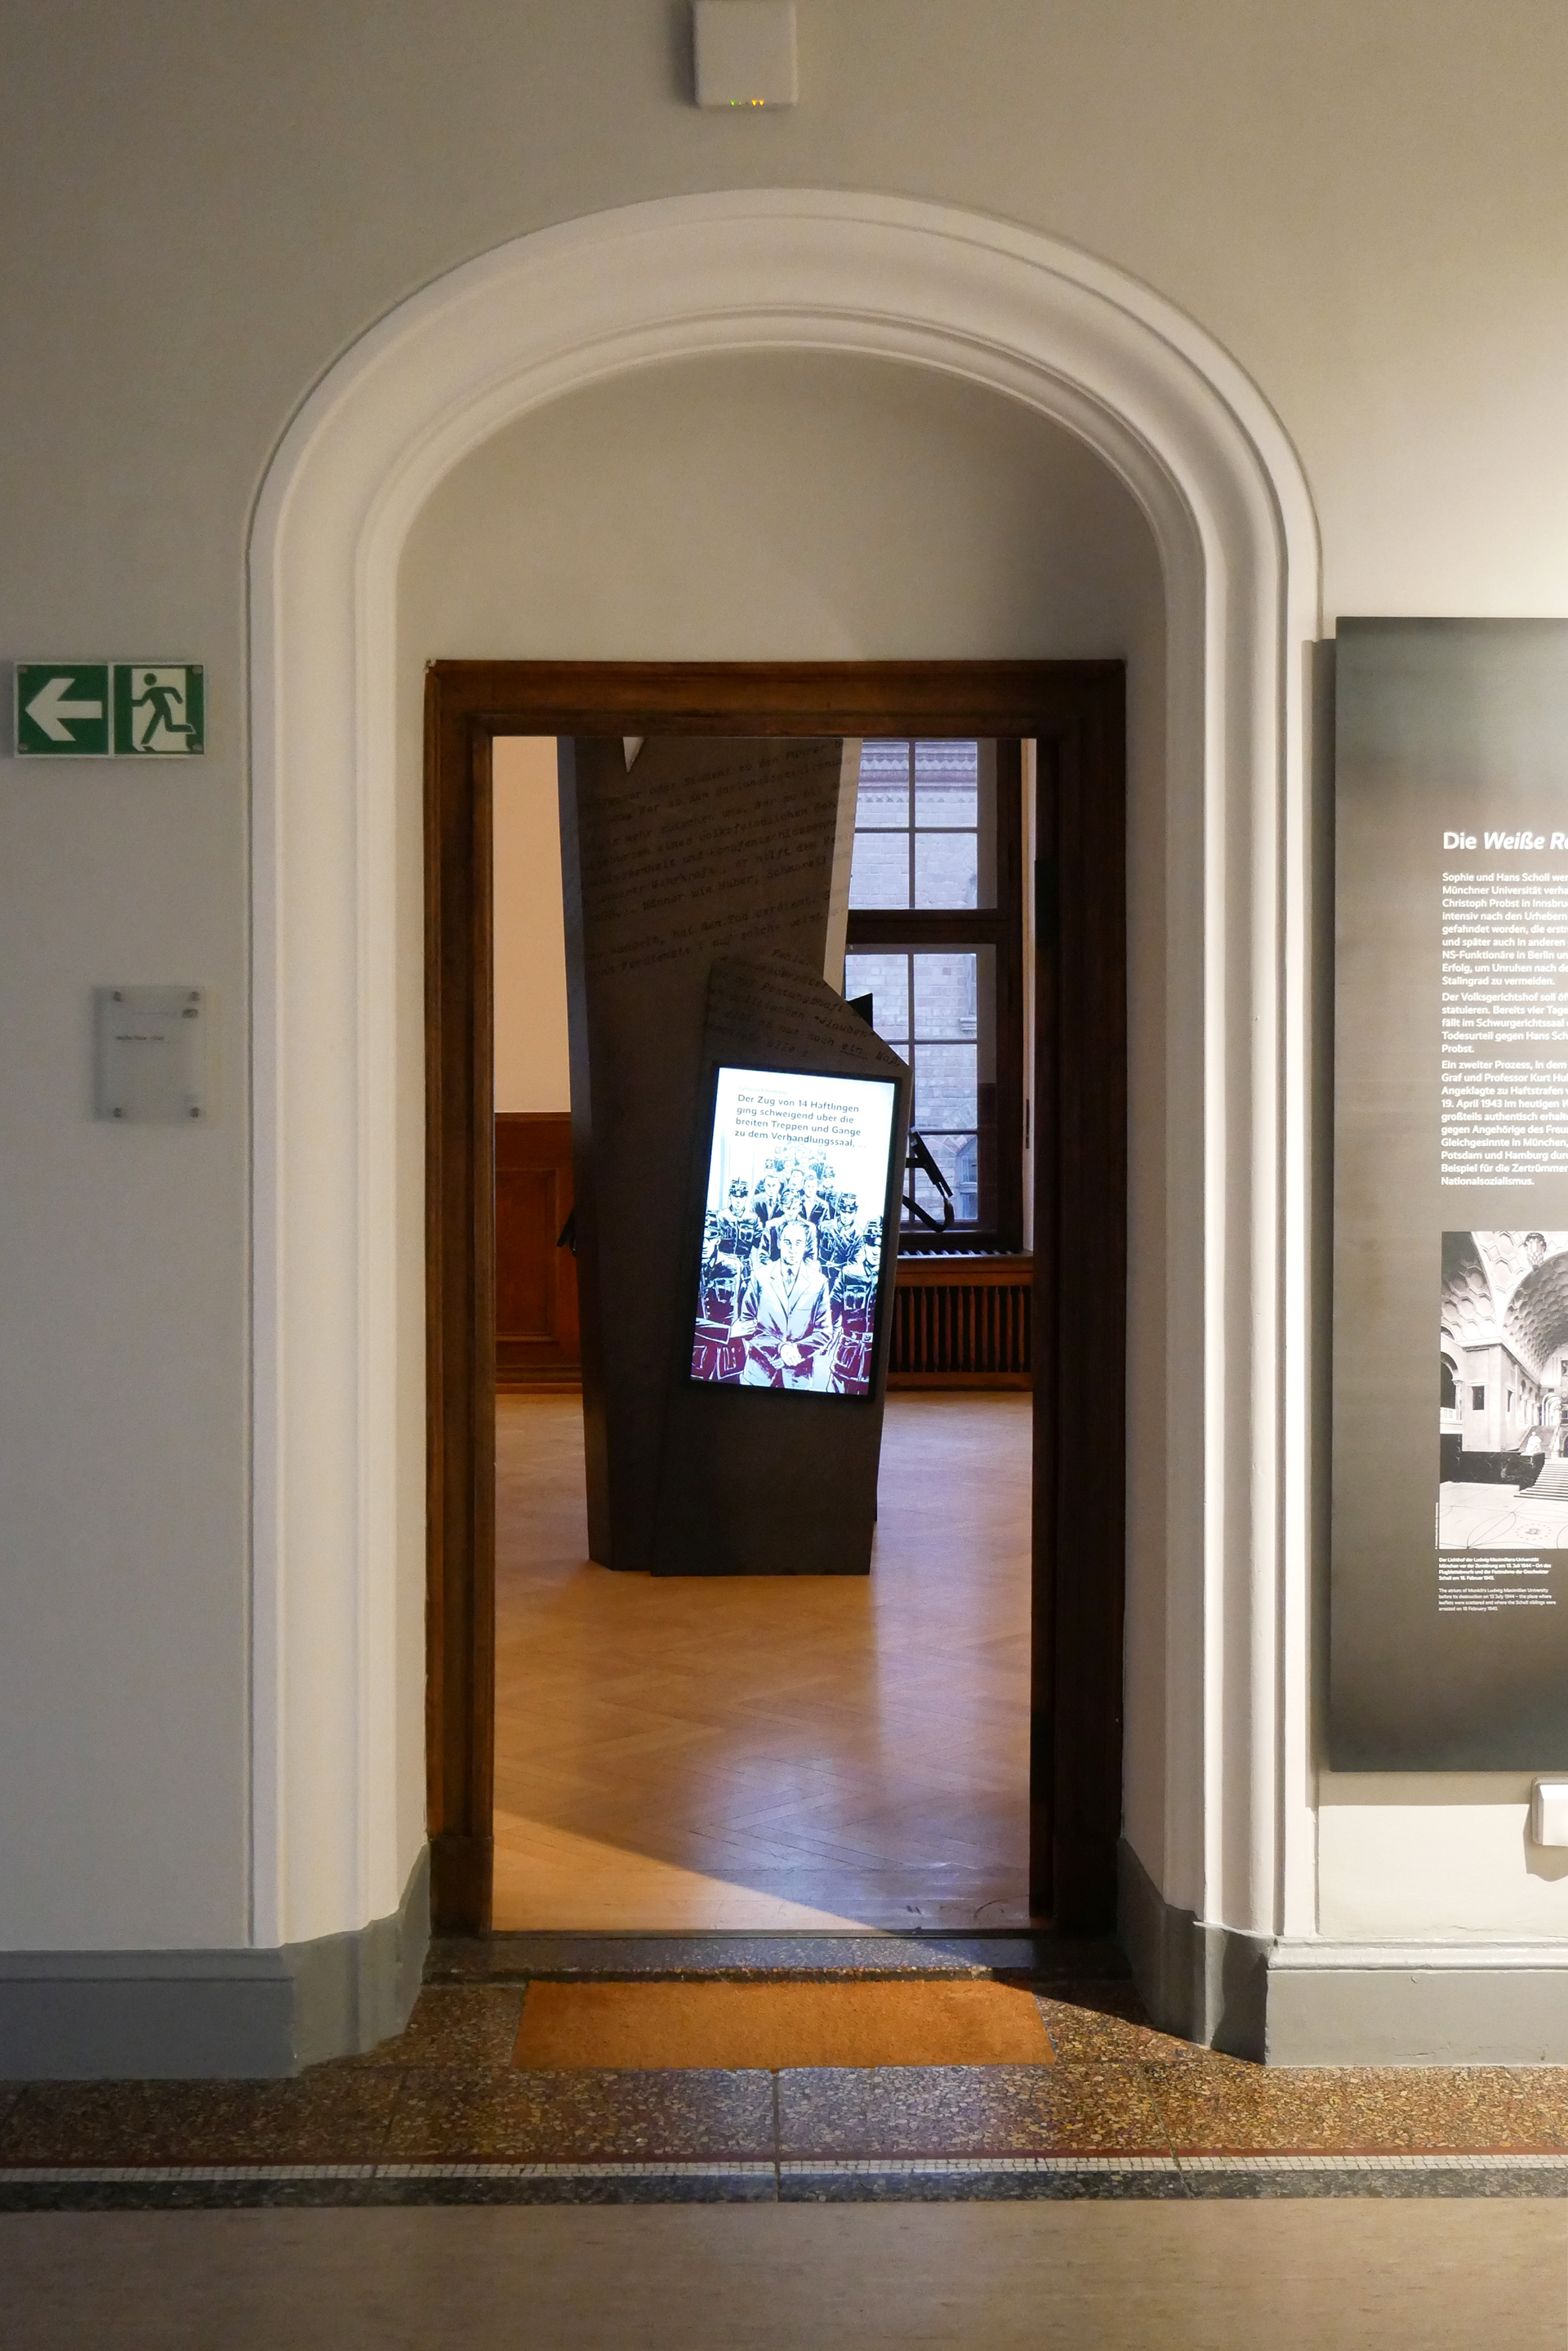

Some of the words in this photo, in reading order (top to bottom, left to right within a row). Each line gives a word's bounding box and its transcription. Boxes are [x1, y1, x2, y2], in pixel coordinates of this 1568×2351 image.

[1444, 832, 1477, 850] Die
[1484, 832, 1545, 850] Weiße
[1442, 872, 1474, 883] Sophie
[1477, 872, 1494, 881] und
[1496, 873, 1521, 881] Hans
[1521, 872, 1550, 881] Scholl
[1442, 886, 1490, 894] Münchner
[1491, 886, 1542, 894] Universität
[1442, 899, 1487, 909] Christoph
[1490, 899, 1520, 908] Probst
[1521, 899, 1530, 908] in
[1442, 912, 1479, 920] intensiv
[1481, 912, 1503, 921] nach
[1504, 912, 1522, 921] den
[1525, 912, 1567, 921] Urhebern
[1442, 924, 1490, 935] gefahndet
[1491, 924, 1529, 935] worden,
[1530, 924, 1545, 934] die
[1442, 937, 1460, 946] und
[1462, 938, 1491, 948] später
[1493, 938, 1515, 946] auch
[1517, 938, 1526, 946] in
[1528, 938, 1565, 946] anderen
[1442, 950, 1515, 959] NS-Funktionäre
[1517, 951, 1526, 959] in
[1527, 950, 1555, 959] Berlin
[1442, 963, 1472, 974] Erfolg,
[1492, 963, 1532, 972] Unruhen
[1534, 963, 1557, 972] nach
[1441, 976, 1489, 987] Stalingrad
[1503, 976, 1555, 985] vermeiden.
[1442, 993, 1459, 1001] Der
[1460, 992, 1539, 1003] Volksgerichtshof
[1539, 993, 1557, 1002] soll
[1441, 1006, 1490, 1014] statuieren.
[1493, 1006, 1526, 1015] Bereits
[1526, 1006, 1545, 1015] vier
[1441, 1018, 1460, 1027] fällt
[1462, 1019, 1474, 1027] im
[1476, 1018, 1564, 1029] Schwurgerichtssaal
[1441, 1031, 1494, 1040] Todesurteil
[1494, 1033, 1525, 1042] gegen
[1526, 1031, 1550, 1040] Hans
[1441, 1044, 1475, 1053] Probst.
[1441, 1060, 1457, 1068] Ein
[1459, 1060, 1493, 1069] zweiter
[1494, 1060, 1533, 1070] Prozess,
[1535, 1060, 1544, 1069] in
[1546, 1060, 1568, 1069] dem
[1441, 1073, 1462, 1082] Graf
[1464, 1073, 1482, 1082] und
[1484, 1073, 1529, 1082] Professor
[1530, 1073, 1551, 1082] Kurt
[1441, 1086, 1495, 1097] Angeklagte
[1510, 1086, 1564, 1095] Haftstrafen
[738, 1095, 754, 1103] Der
[758, 1096, 774, 1106] Zug
[1441, 1099, 1454, 1108] 19.
[1455, 1099, 1479, 1109] April
[1481, 1099, 1503, 1108] 1943
[1504, 1100, 1517, 1108] im
[1518, 1099, 1560, 1110] heutigen
[737, 1107, 757, 1116] ging
[760, 1109, 813, 1120] schweigend
[1441, 1112, 1482, 1122] großteils
[1484, 1112, 1538, 1121] authentisch
[736, 1118, 768, 1127] breiten
[772, 1121, 808, 1131] Treppen
[1441, 1126, 1470, 1135] gegen
[1472, 1125, 1526, 1135] Angehörige
[1527, 1125, 1544, 1134] des
[748, 1131, 768, 1139] dem
[772, 1132, 854, 1148] Verhandlungssaal,
[1441, 1138, 1510, 1149] Gleichgesinnte
[1512, 1138, 1521, 1146] in
[1441, 1150, 1482, 1159] Potsdam
[1485, 1151, 1503, 1160] und
[1504, 1150, 1548, 1162] Hamburg
[1441, 1163, 1477, 1174] Beispiel
[1479, 1163, 1494, 1172] für
[1495, 1163, 1510, 1172] die
[1441, 1176, 1535, 1185] Nationalsozialismus.
